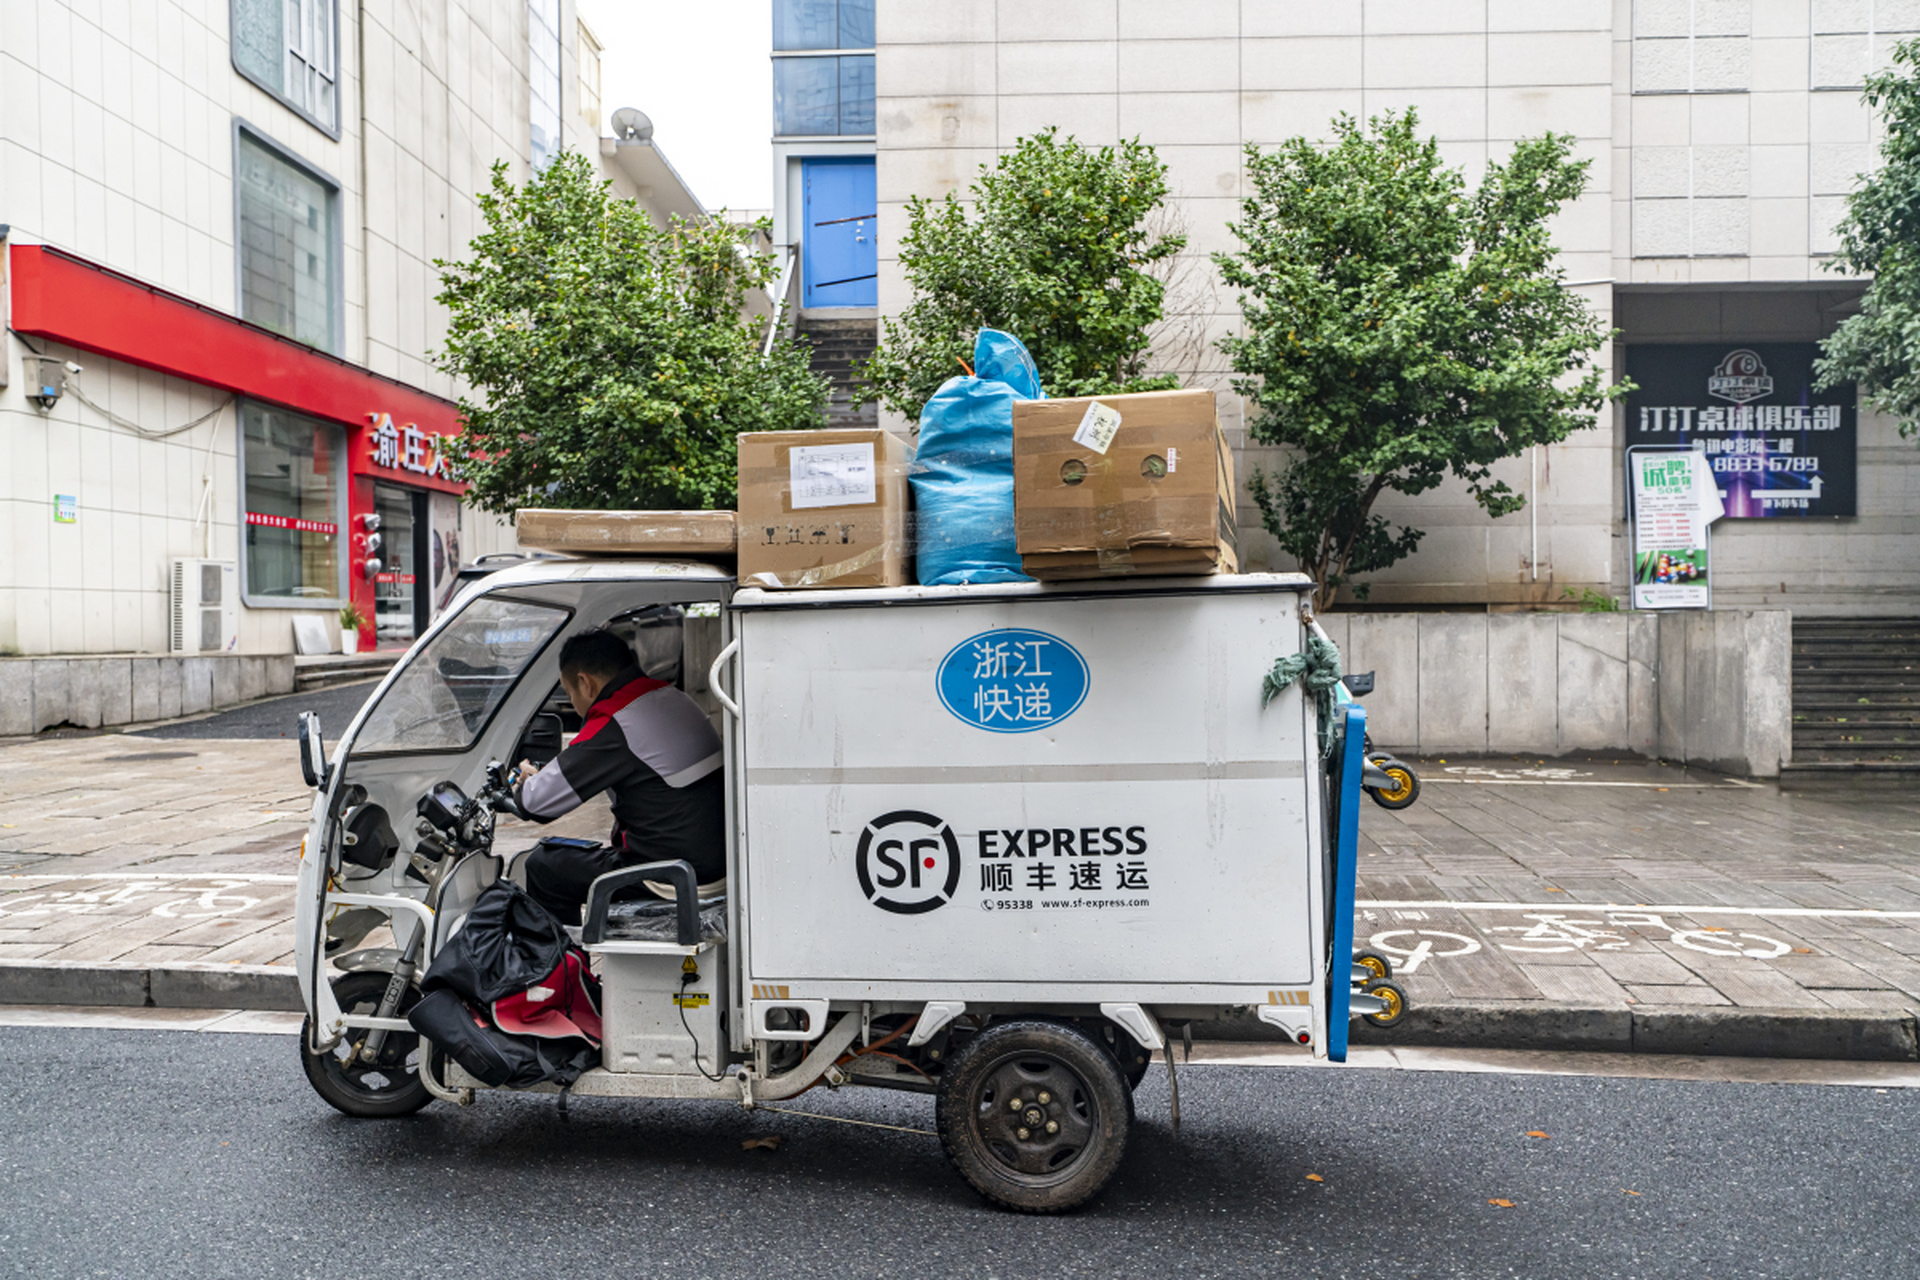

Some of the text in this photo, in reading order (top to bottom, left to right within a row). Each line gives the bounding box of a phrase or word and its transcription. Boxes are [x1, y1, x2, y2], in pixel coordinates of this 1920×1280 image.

[1640, 405, 1841, 431] 汀汀桌球俱乐部
[1714, 457, 1819, 472] 8833 6789
[973, 641, 1052, 679] 浙江
[974, 682, 1053, 723] 快递
[978, 826, 1148, 858] EXPRESS
[876, 838, 940, 889] SF
[980, 861, 1149, 891] 顺丰速运
[997, 898, 1150, 910] 95338 www.sf-express.com
